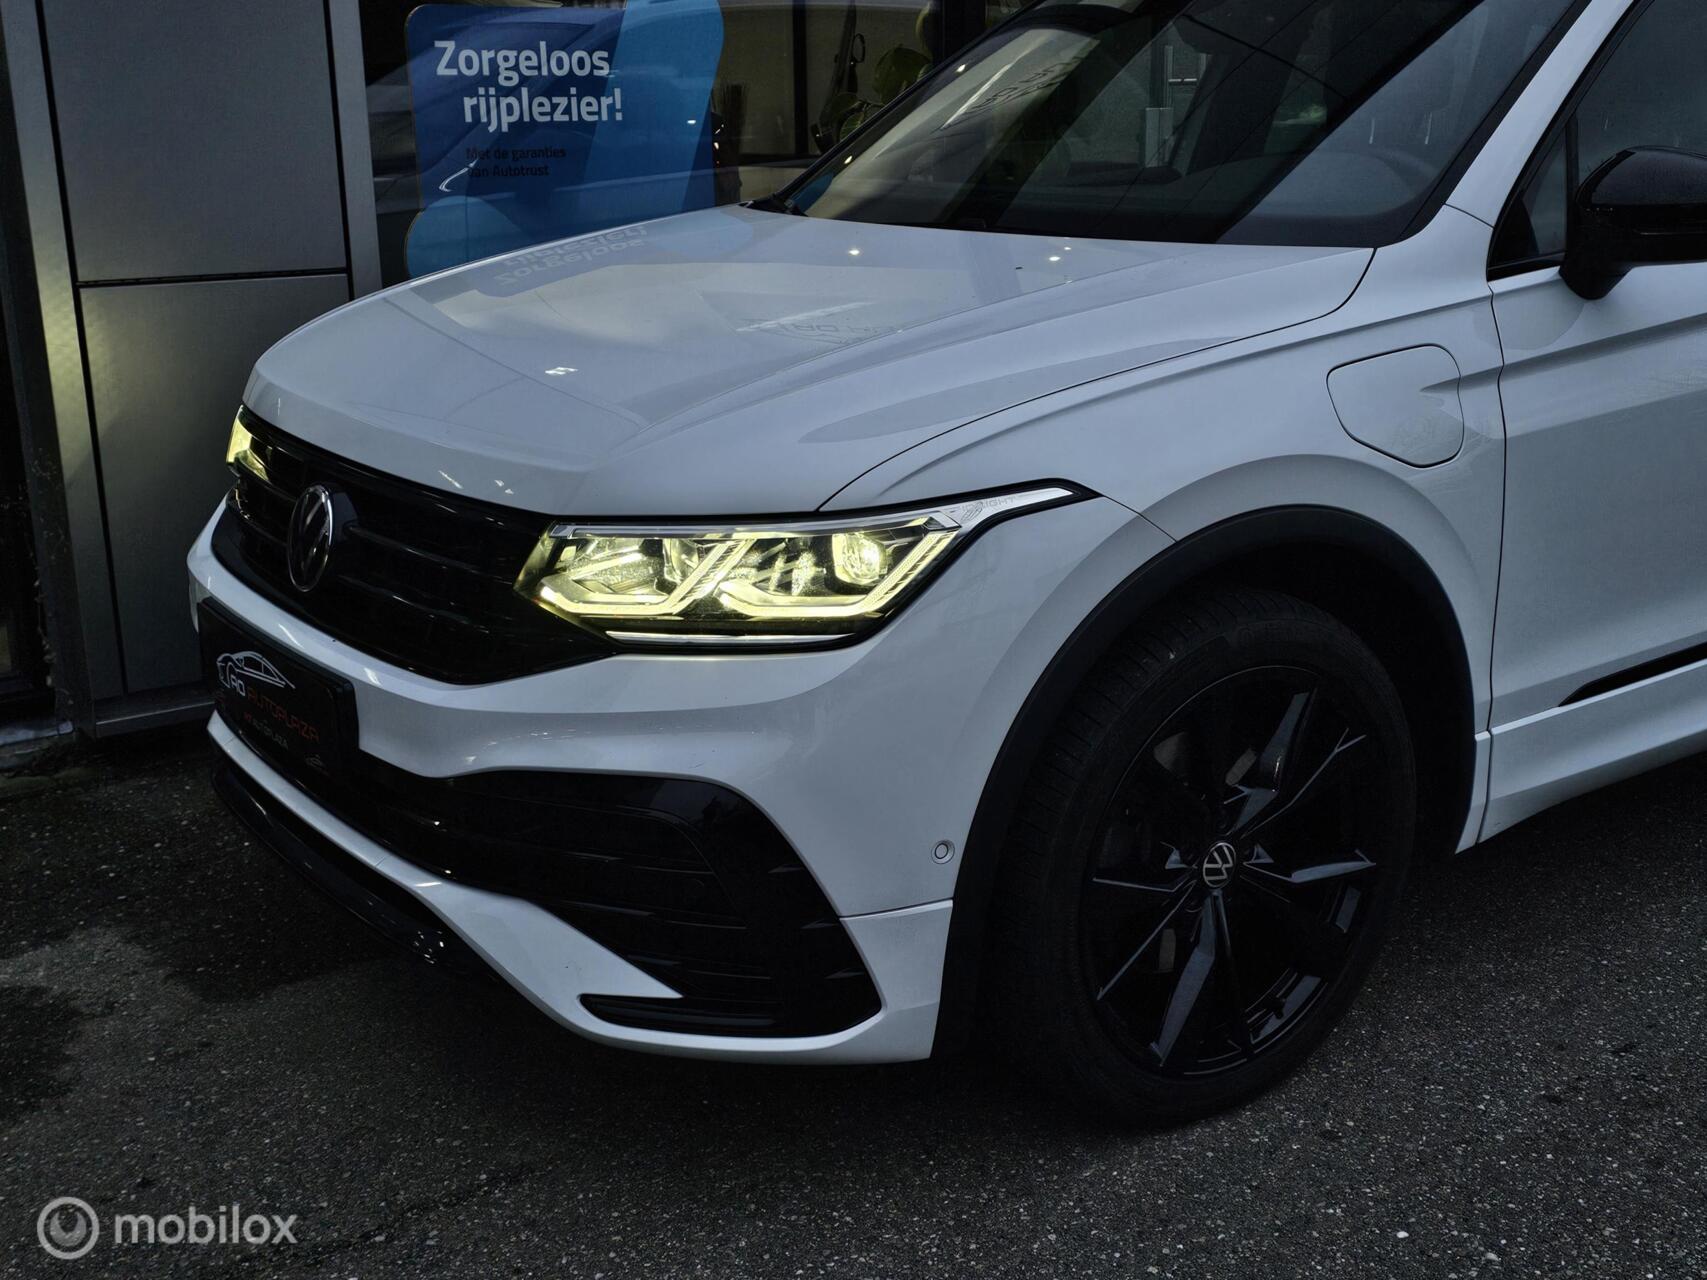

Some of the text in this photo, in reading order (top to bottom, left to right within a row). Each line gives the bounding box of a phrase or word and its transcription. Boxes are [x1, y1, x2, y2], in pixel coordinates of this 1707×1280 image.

[434, 40, 610, 87] Zorgeloos
[463, 87, 623, 133] rijplezier!
[494, 147, 509, 160] de
[511, 146, 567, 162] garanties
[492, 165, 549, 177] Autotrust
